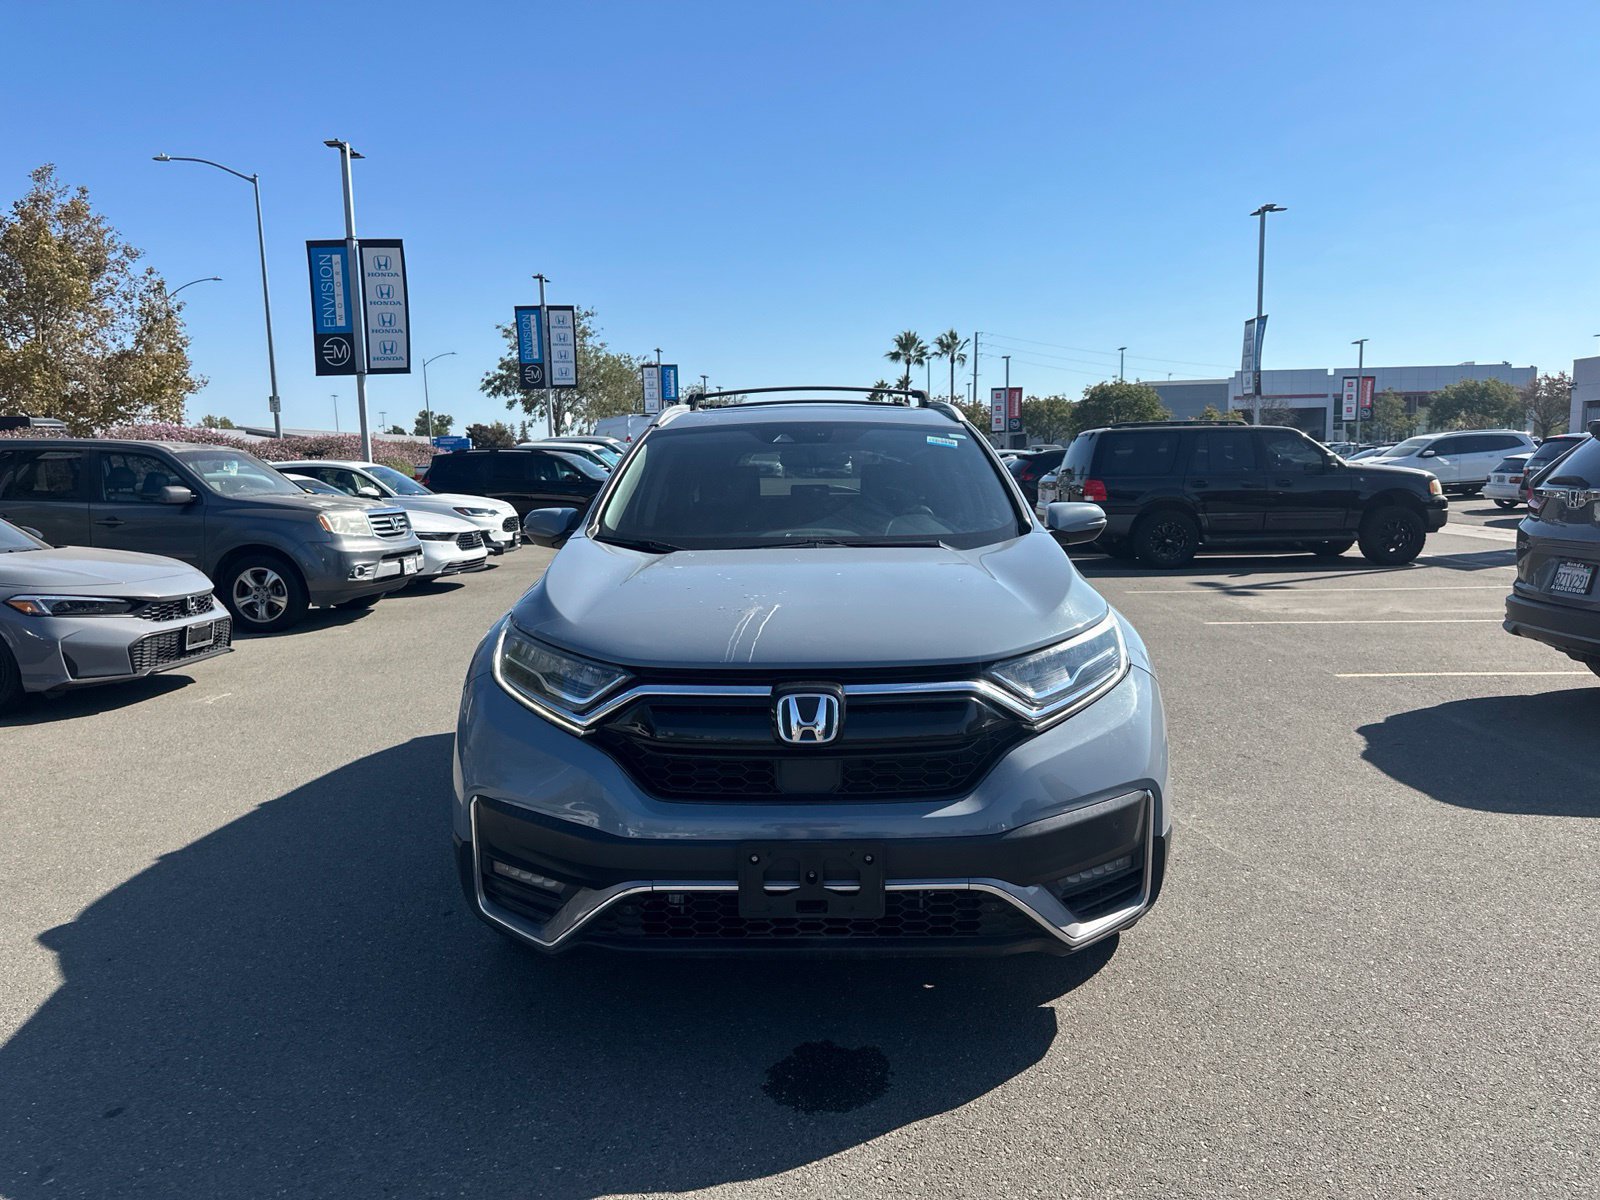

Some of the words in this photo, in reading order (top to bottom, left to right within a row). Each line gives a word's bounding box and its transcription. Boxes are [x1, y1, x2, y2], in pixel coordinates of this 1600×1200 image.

[318, 254, 336, 328] ENVISION
[334, 260, 344, 321] MOTORS
[522, 314, 533, 360] ENVISION
